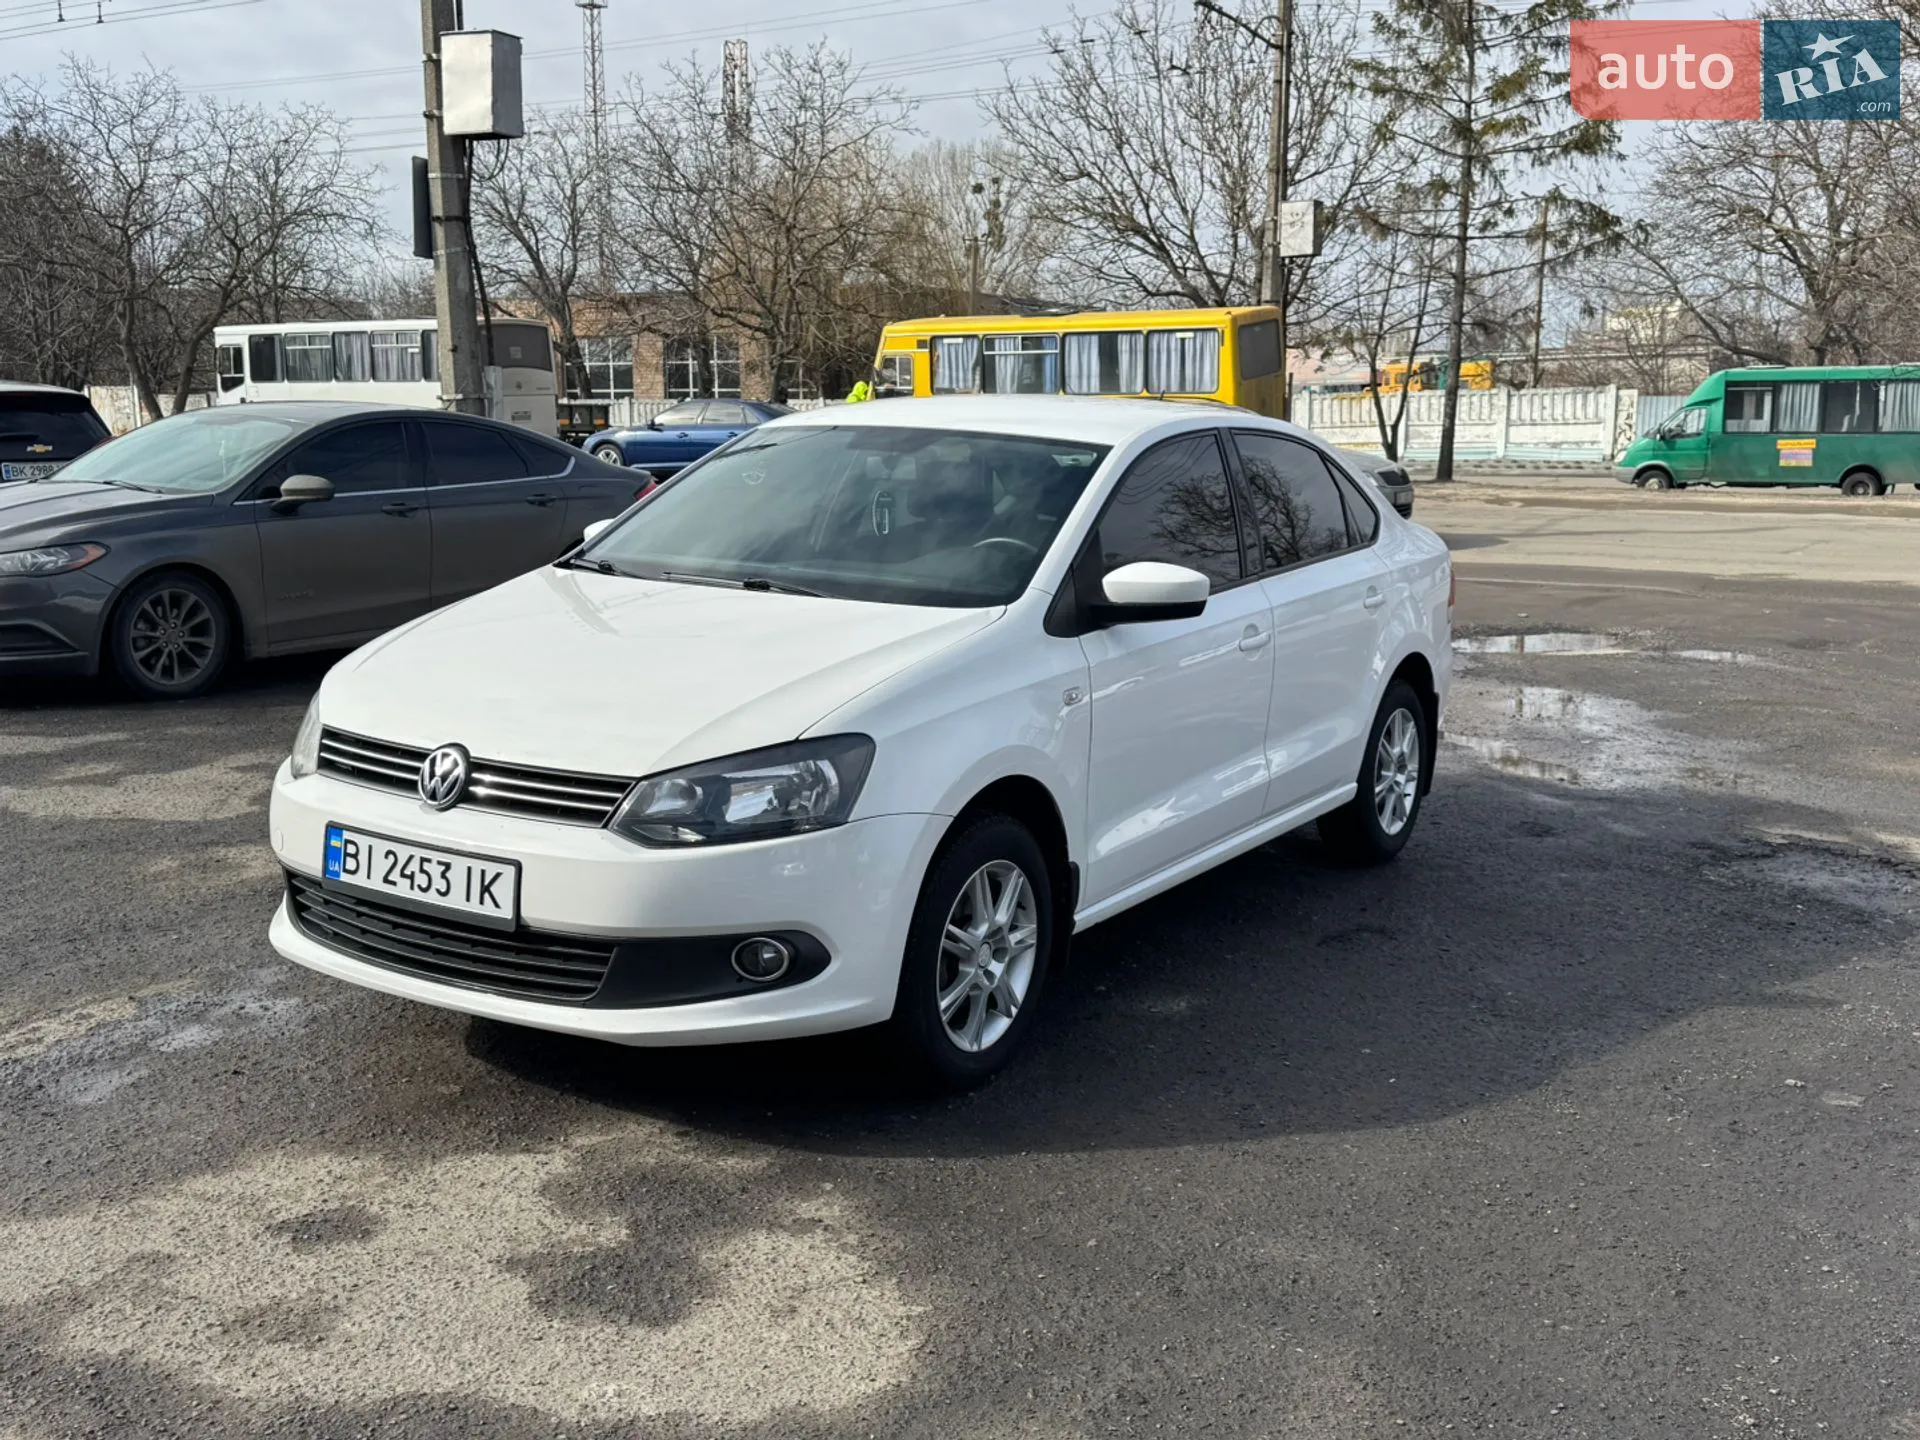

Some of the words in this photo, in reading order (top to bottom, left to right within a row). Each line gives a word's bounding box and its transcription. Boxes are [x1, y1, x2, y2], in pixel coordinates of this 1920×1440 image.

[11, 466, 28, 477] BK
[328, 859, 340, 873] UA
[342, 838, 373, 880] BI
[382, 849, 451, 897] 2453
[465, 865, 504, 909] IK
